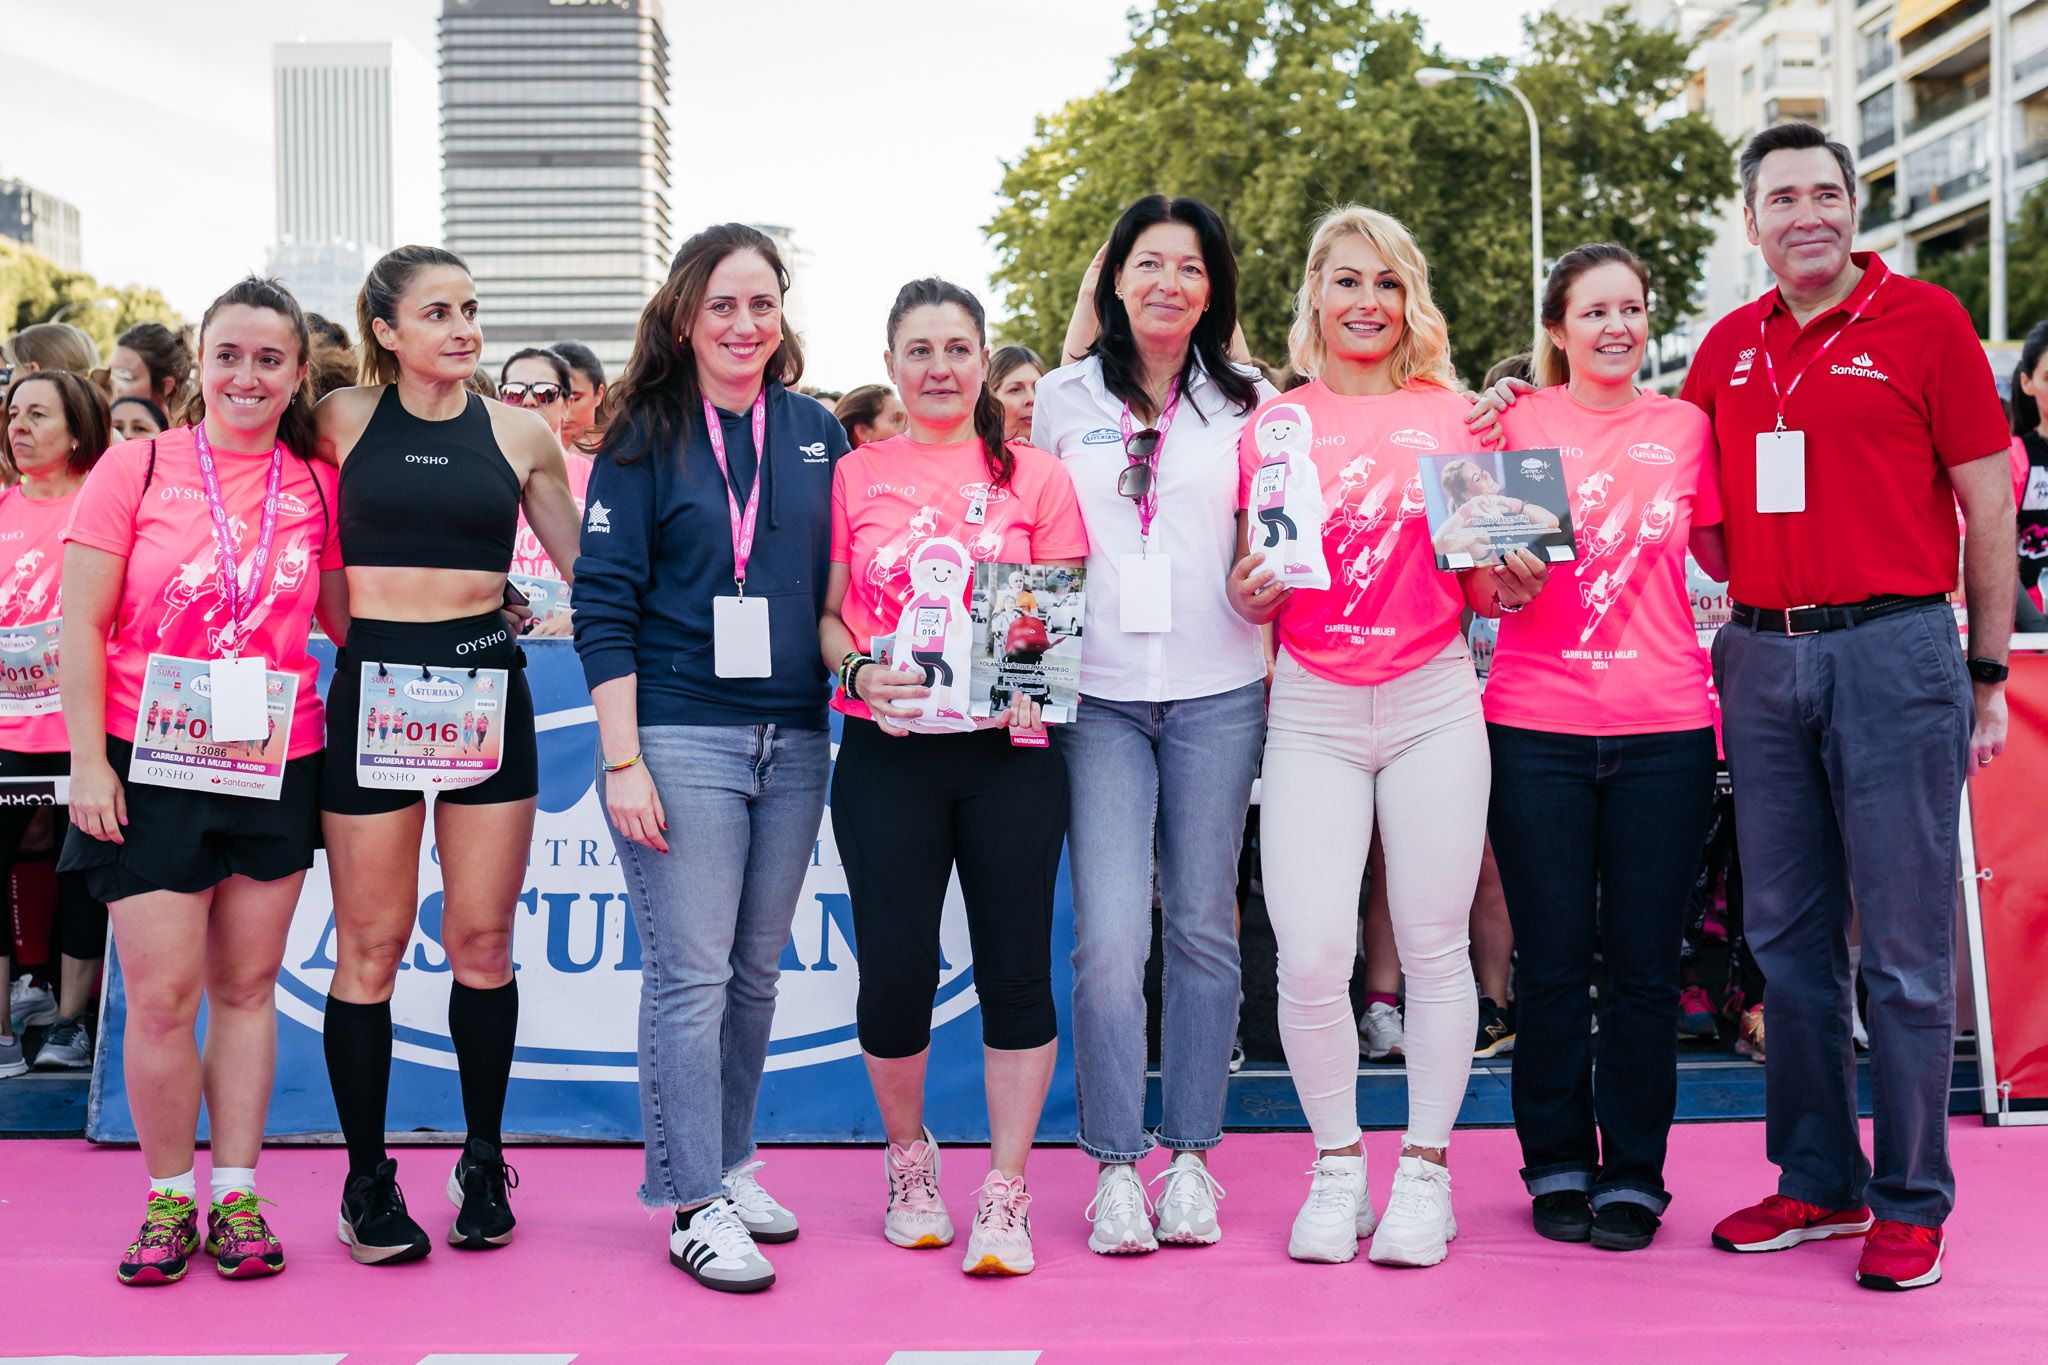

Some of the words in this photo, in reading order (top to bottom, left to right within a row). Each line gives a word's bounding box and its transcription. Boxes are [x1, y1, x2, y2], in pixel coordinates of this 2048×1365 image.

[1831, 365, 1888, 382] Santander
[405, 455, 449, 465] OYSHO
[1632, 449, 1673, 461] ASTURIANA
[1263, 484, 1277, 493] 016
[922, 628, 936, 636] 016
[1324, 624, 1352, 634] CARRERA
[1352, 625, 1360, 635] DE
[1361, 626, 1370, 636] LA
[1371, 626, 1396, 636] MUJER
[456, 629, 507, 655] OYSHO
[1351, 635, 1365, 645] 2024
[1561, 650, 1592, 660] CARRERA
[1593, 650, 1603, 659] DE
[1604, 651, 1613, 659] LA
[1614, 650, 1638, 659] MUJER
[979, 661, 1006, 669] YOLANDA
[1035, 664, 1070, 673] MAZARIEGO
[1592, 660, 1609, 670] 2024
[7, 664, 44, 682] 016
[157, 668, 182, 678] SUMA
[371, 676, 394, 685] SUMA
[407, 684, 460, 697] ASTURIANA
[406, 722, 458, 742] 016
[195, 745, 227, 758] 13086
[423, 748, 435, 757] 32
[151, 751, 184, 763] CARRERA
[186, 755, 196, 764] DE
[197, 757, 206, 766] LA
[208, 759, 232, 768] MUJER
[237, 763, 266, 773] MADRID
[374, 756, 404, 766] CARRERA
[406, 758, 417, 766] DE
[418, 758, 426, 766] LA
[428, 759, 450, 767] MUJER
[456, 760, 483, 768] MADRID
[147, 766, 194, 782] OYSHO
[372, 771, 415, 782] OYSHO
[443, 775, 484, 784] Santander
[222, 777, 266, 790] Santander
